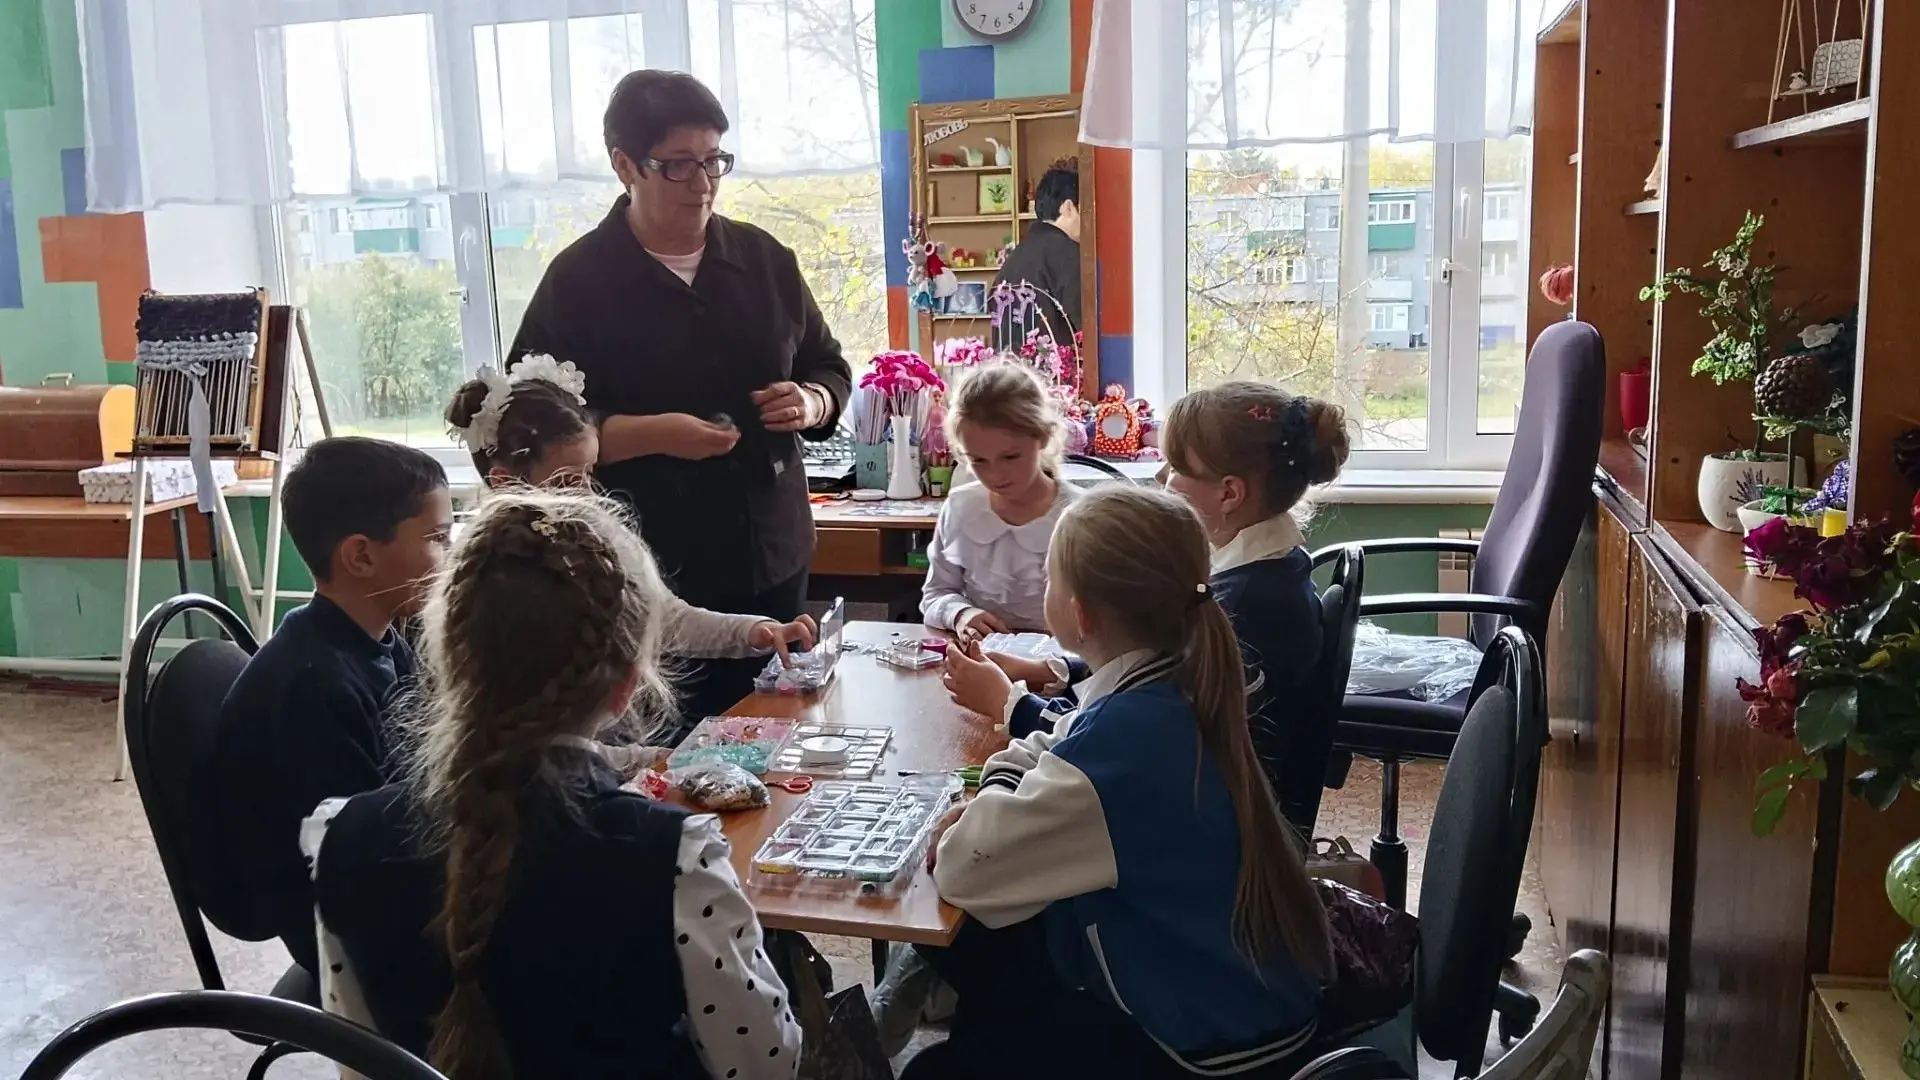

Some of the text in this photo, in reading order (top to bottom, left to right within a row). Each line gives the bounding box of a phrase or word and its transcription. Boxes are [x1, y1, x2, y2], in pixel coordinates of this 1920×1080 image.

[969, 3, 976, 14] 8
[1017, 1, 1024, 11] 4
[979, 14, 987, 24] 7
[994, 16, 1001, 28] 6
[1007, 13, 1014, 24] 5
[923, 119, 969, 146] ЛЮБОВЬ
